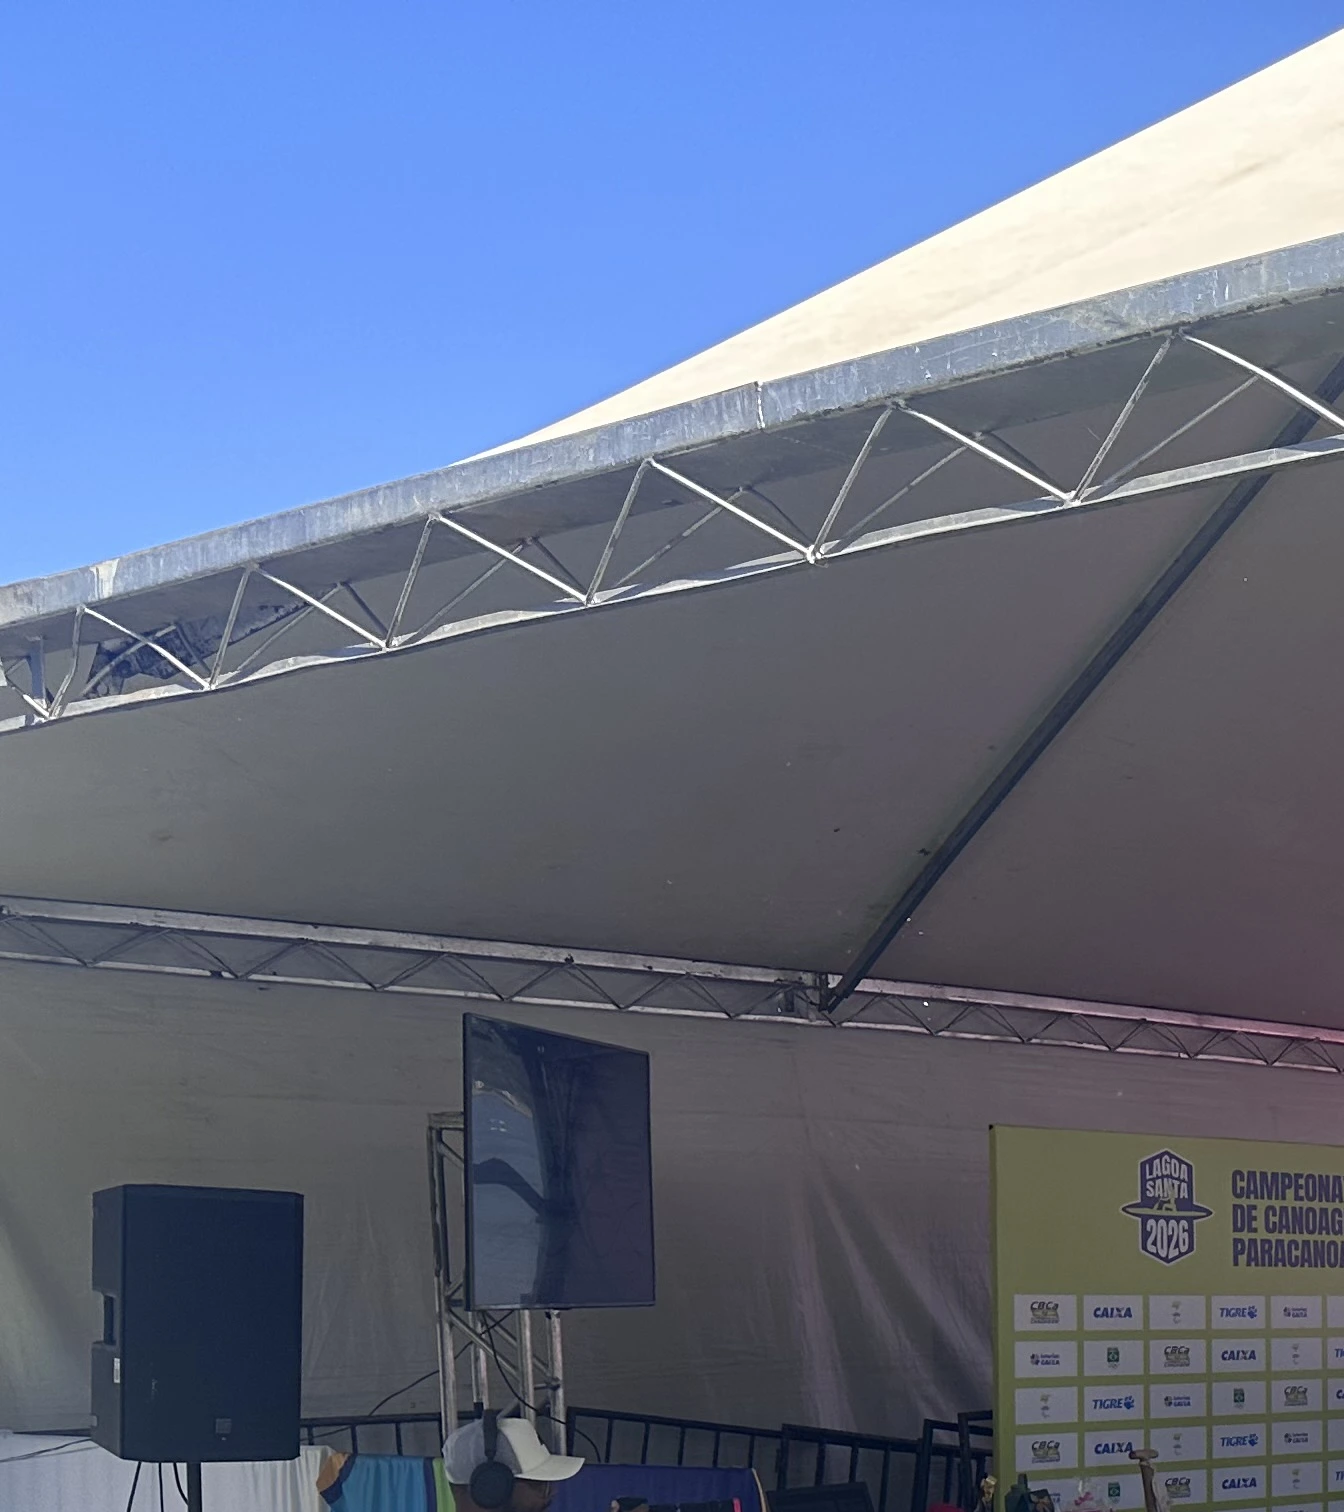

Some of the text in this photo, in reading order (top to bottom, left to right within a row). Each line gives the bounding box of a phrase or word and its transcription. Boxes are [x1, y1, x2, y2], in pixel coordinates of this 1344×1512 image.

[1145, 1154, 1189, 1182] LAGOA
[1145, 1178, 1188, 1200] SANTA
[1232, 1204, 1258, 1234] DE
[1146, 1218, 1189, 1259] 2026
[1093, 1307, 1132, 1318] CAIXA
[1221, 1350, 1256, 1361] CAIXA
[1094, 1441, 1134, 1454] CAIXA
[1222, 1477, 1257, 1490] CAIXA
